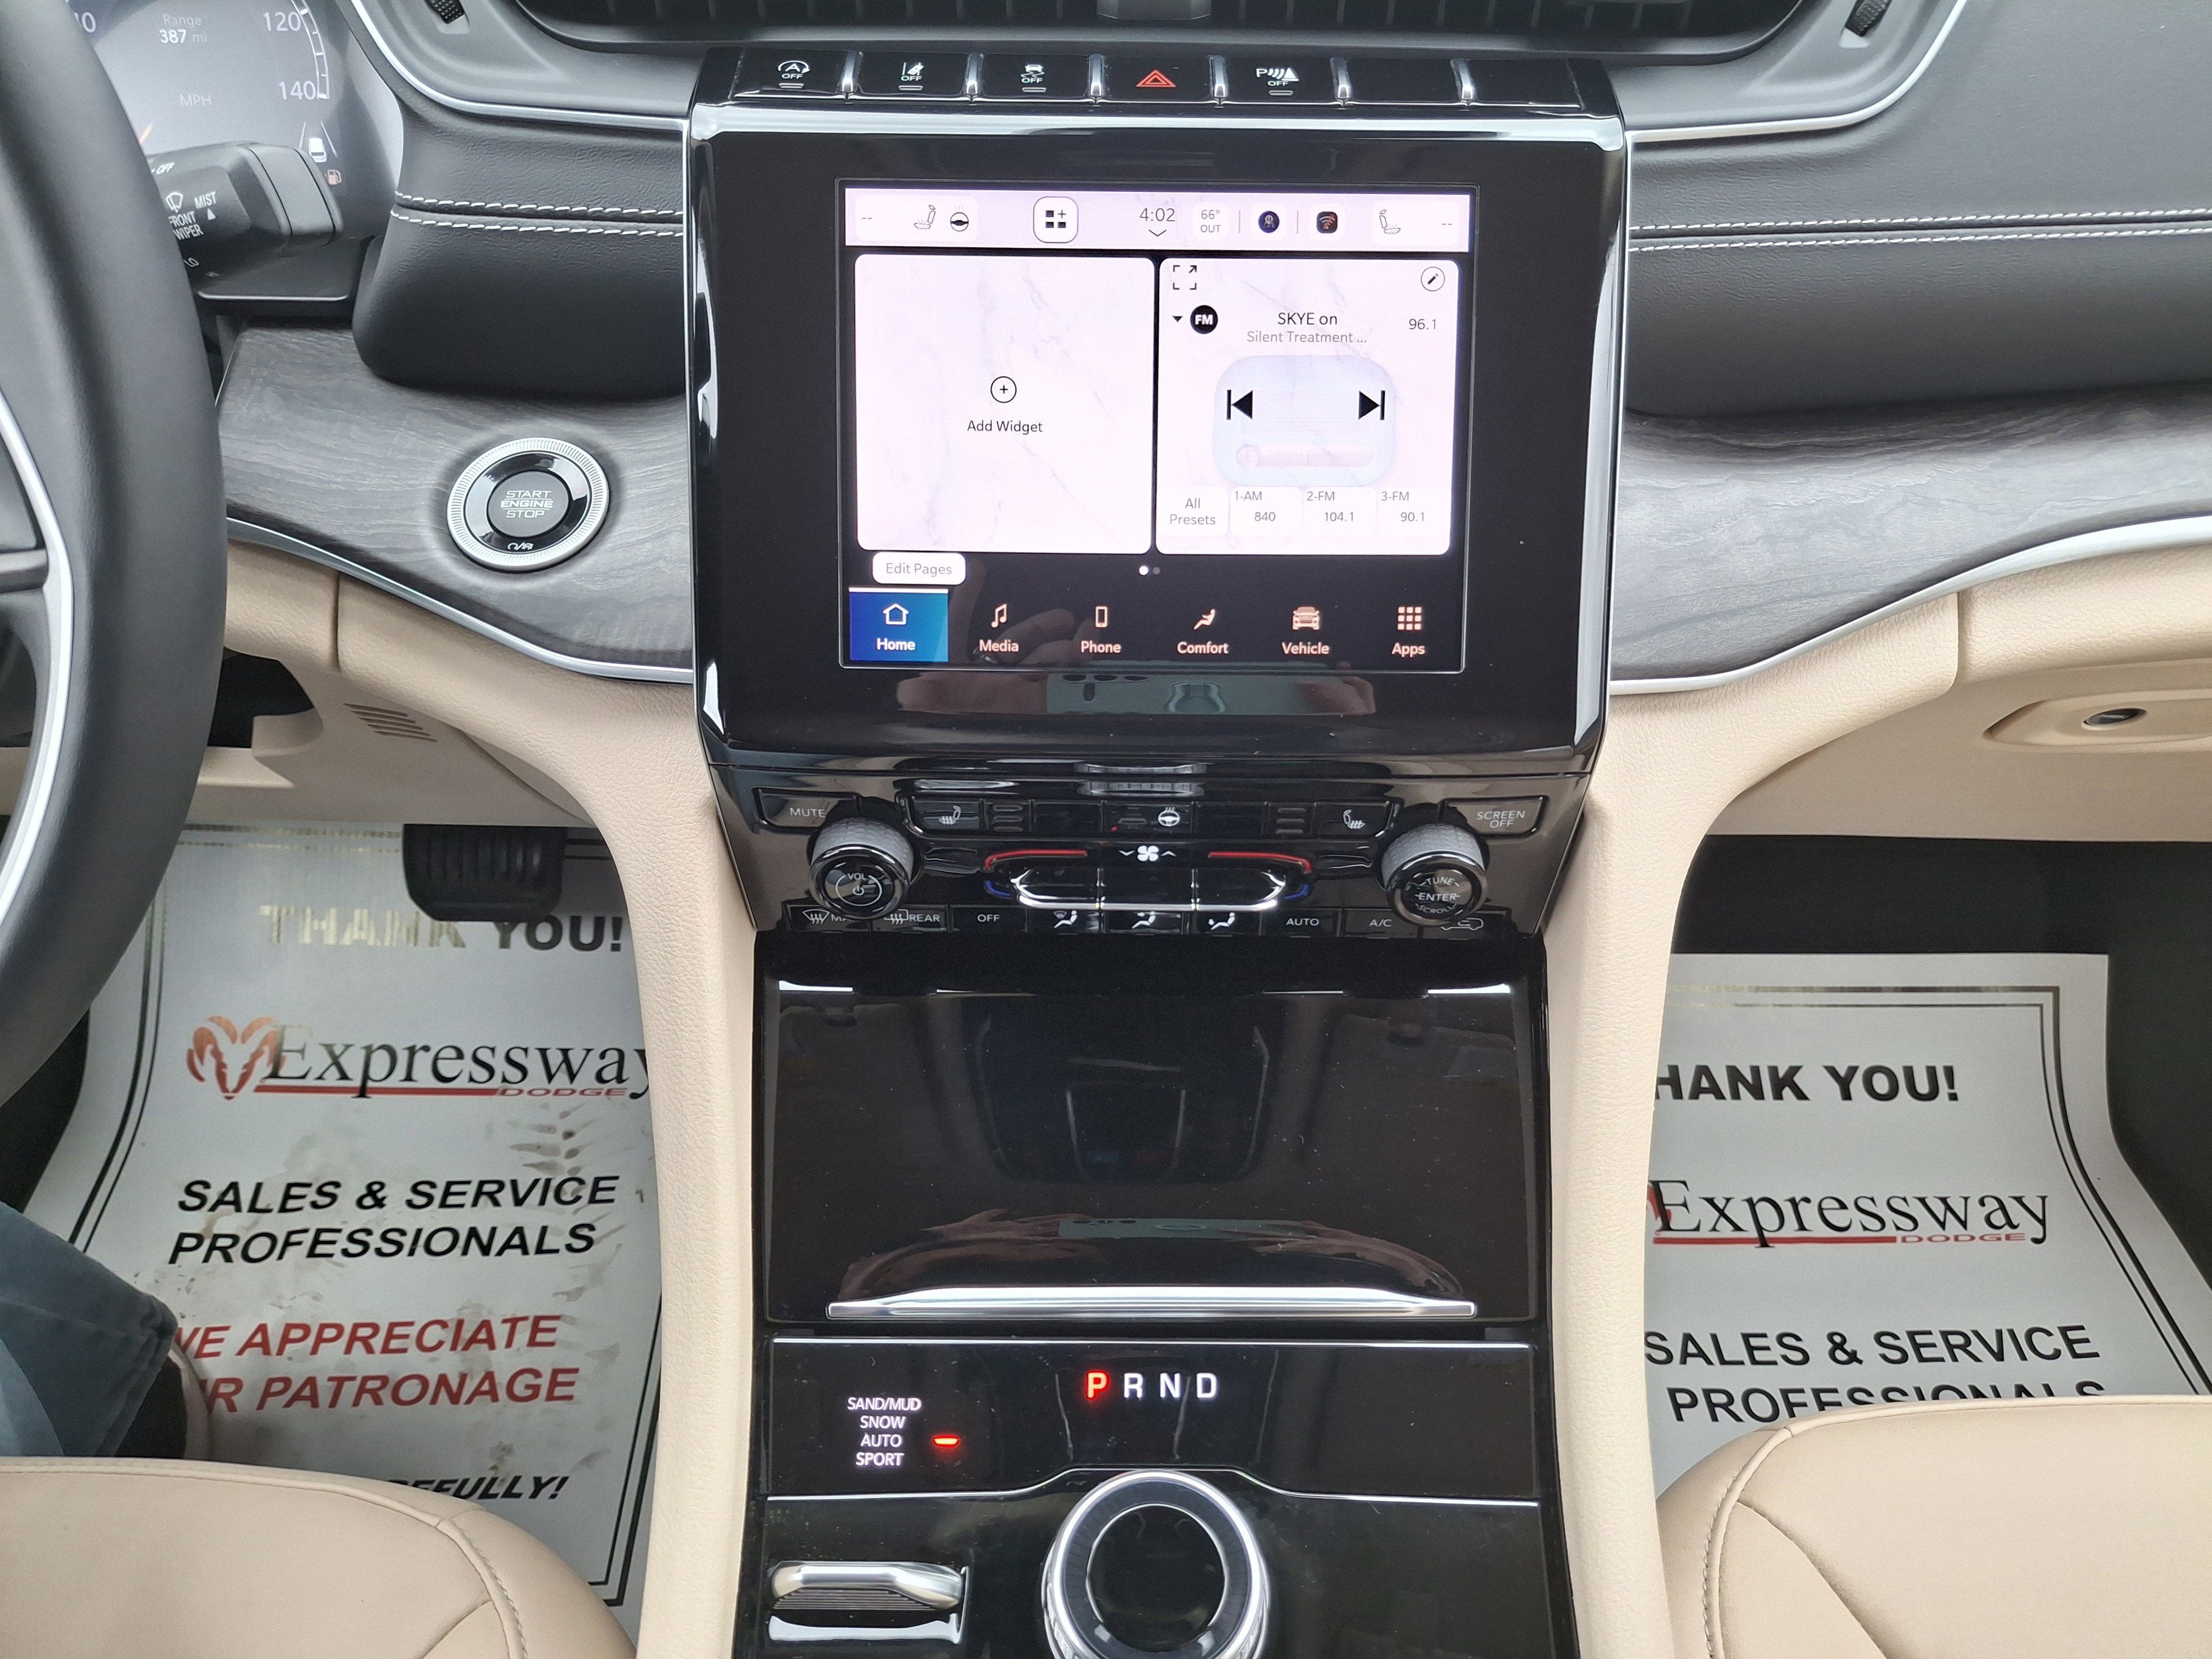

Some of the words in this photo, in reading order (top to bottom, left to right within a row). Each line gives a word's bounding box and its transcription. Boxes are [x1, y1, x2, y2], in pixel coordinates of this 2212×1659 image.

[163, 14, 202, 28] Range
[263, 12, 301, 31] 120
[159, 29, 187, 43] 387
[192, 31, 208, 43] mi
[279, 81, 316, 100] 140
[180, 94, 212, 106] MPH
[156, 163, 175, 174] OFF
[194, 191, 217, 209] MIST
[168, 210, 197, 227] FRONT
[1139, 208, 1175, 223] 4:02
[172, 224, 204, 240] WIPER
[1200, 223, 1221, 234] OUT
[1194, 314, 1213, 325] FM
[1277, 312, 1315, 326] SKYE
[1319, 315, 1338, 325] on
[1409, 319, 1437, 330] 96.1
[1247, 331, 1283, 343] Silent
[1287, 332, 1353, 343] Treatment
[967, 420, 993, 433] Add
[996, 420, 1043, 435] Widget
[506, 490, 552, 498] START
[1234, 491, 1263, 501] 1-AM
[1307, 491, 1335, 501] 2-FM
[1381, 491, 1410, 501] 3-FM
[500, 500, 554, 509] ENGINE
[1185, 498, 1201, 509] All
[506, 510, 545, 518] STOP
[1169, 514, 1216, 526] Presets
[1254, 512, 1276, 522] 840
[1324, 512, 1354, 522] 104.1
[1400, 512, 1425, 522] 90.1
[886, 562, 911, 574] Edit
[914, 563, 952, 578] Pages
[877, 638, 916, 651] Home
[979, 639, 1019, 652] Media
[1081, 640, 1122, 653] Phone
[1176, 641, 1229, 654] Comfort
[1282, 641, 1330, 654] Vehicle
[1391, 642, 1425, 658] Apps
[790, 807, 826, 818] MUTE
[1476, 810, 1526, 820] SCREEN
[1489, 819, 1515, 828] OFF
[847, 872, 867, 880] VOL
[1425, 876, 1455, 886] TUNE
[1418, 892, 1457, 902] ENTER
[1417, 904, 1455, 914] SCROLL
[909, 914, 940, 922] REAR
[977, 914, 1000, 922] OFF
[1286, 917, 1319, 927] AUTO
[1369, 918, 1392, 928] A/C
[260, 905, 466, 948] THANK
[492, 915, 623, 952] YOU!
[1655, 1065, 1811, 1101] HANK
[1822, 1065, 1959, 1102] YOU!
[500, 1088, 628, 1097] DODGE
[178, 1179, 342, 1214] SALES
[356, 1180, 387, 1210] &
[406, 1175, 620, 1210] SERVICE
[1648, 1180, 2049, 1248] Expressway
[169, 1223, 596, 1265] PROFESSIONALS
[1900, 1233, 2027, 1243] DODGE
[235, 1315, 562, 1356] APPRECIATE
[1644, 1332, 1810, 1366] SALES
[1826, 1332, 1863, 1366] &
[1873, 1324, 2101, 1365] SERVICE
[256, 1367, 580, 1411] PATRONAGE
[1086, 1372, 1108, 1399] P
[1124, 1373, 1143, 1399] R
[1160, 1373, 1181, 1399] N
[1197, 1373, 1218, 1399] D
[847, 1397, 922, 1411] SAND/MUD
[860, 1416, 905, 1429] SNOW
[860, 1434, 903, 1448] AUTO
[856, 1452, 904, 1467] SPORT
